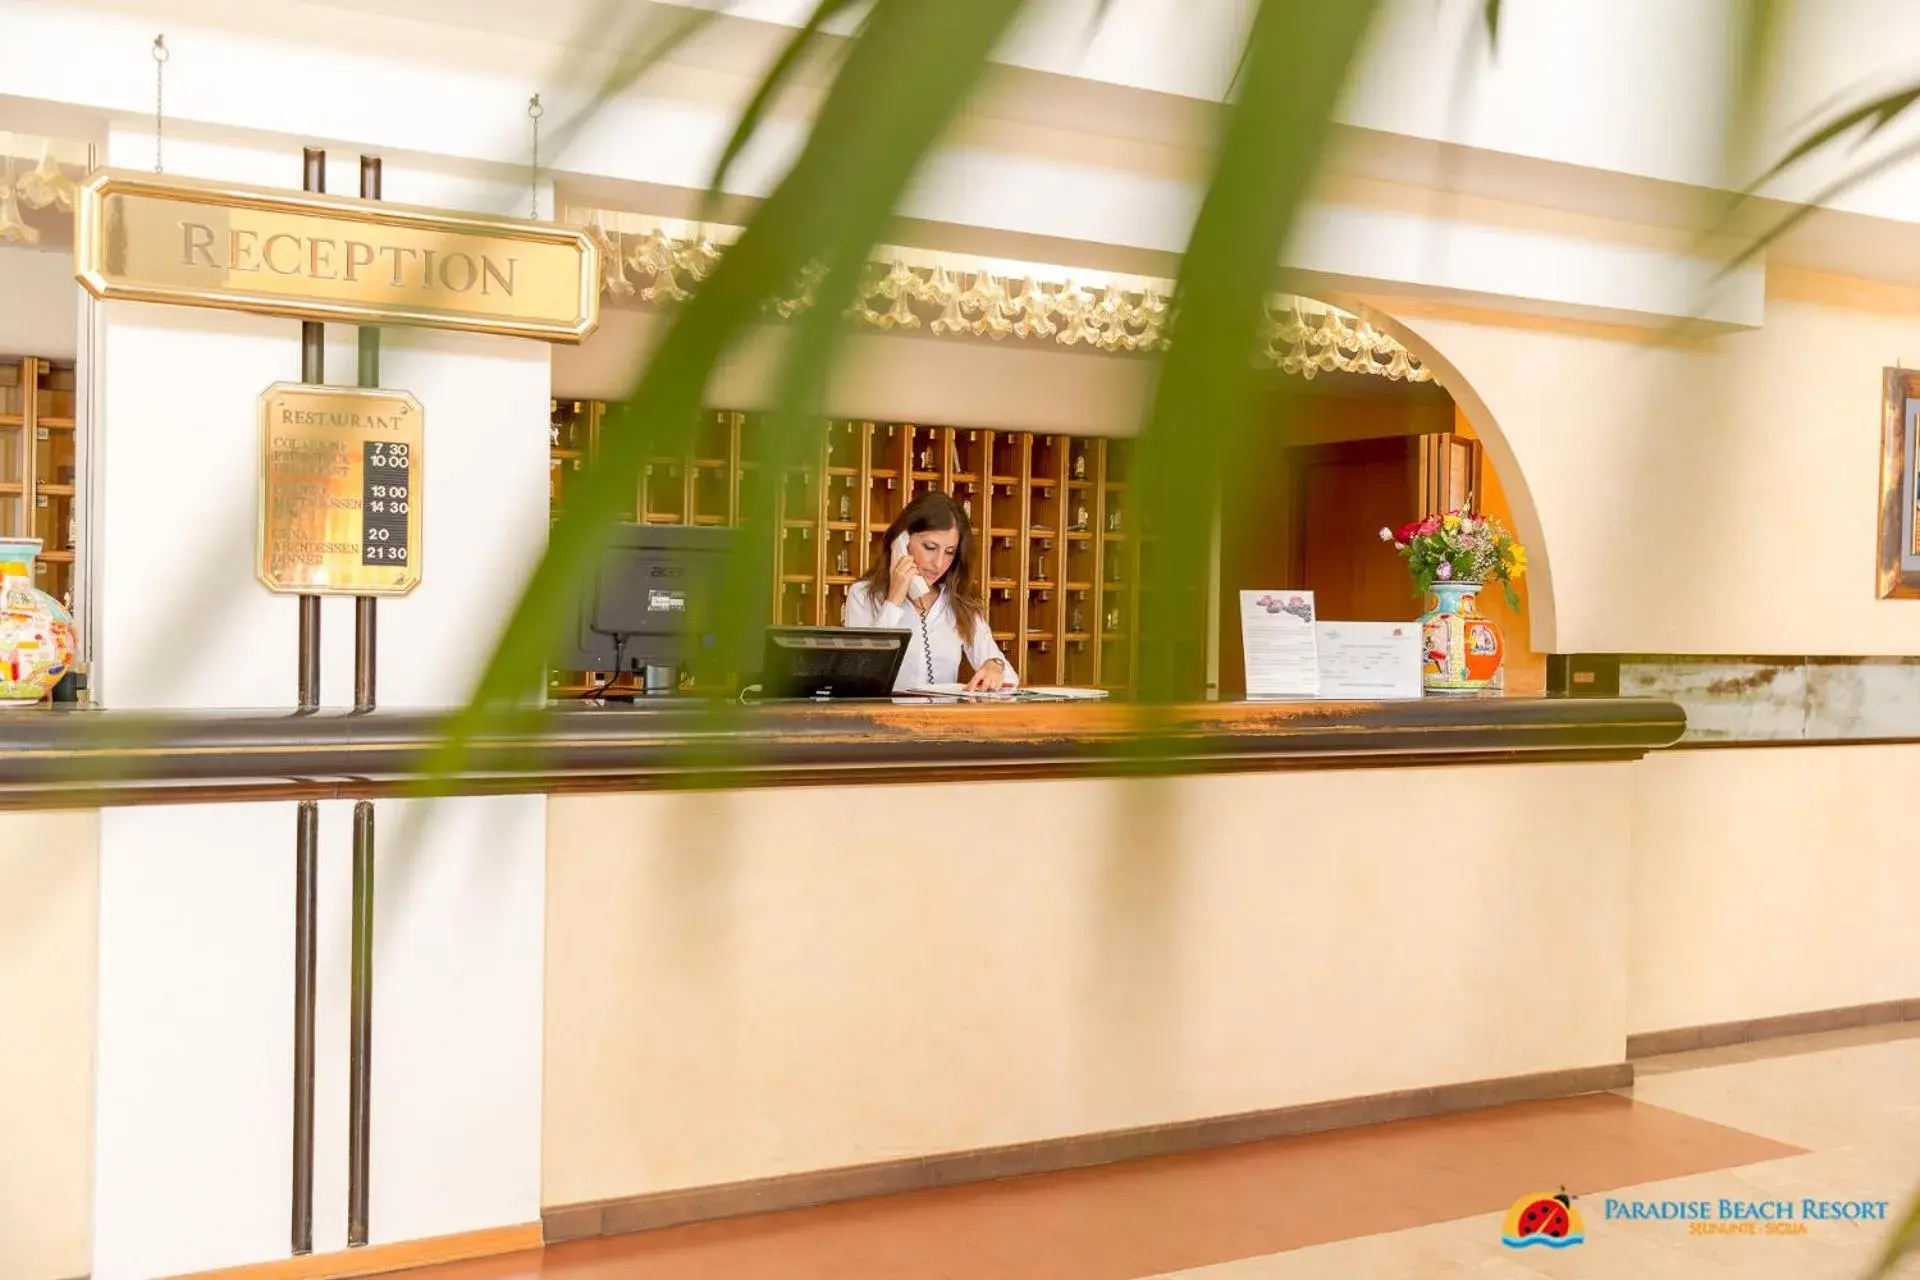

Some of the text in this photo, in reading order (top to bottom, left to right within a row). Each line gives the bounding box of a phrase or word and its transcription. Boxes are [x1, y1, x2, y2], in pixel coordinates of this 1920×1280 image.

[180, 221, 517, 297] RECEPTION
[281, 408, 403, 431] RESTAURANT
[374, 442, 408, 456] 7 30
[370, 454, 409, 469] 10 00
[371, 485, 407, 499] 13 00
[370, 500, 409, 515] 14 30
[368, 527, 390, 541] 20
[366, 546, 407, 560] 21 30
